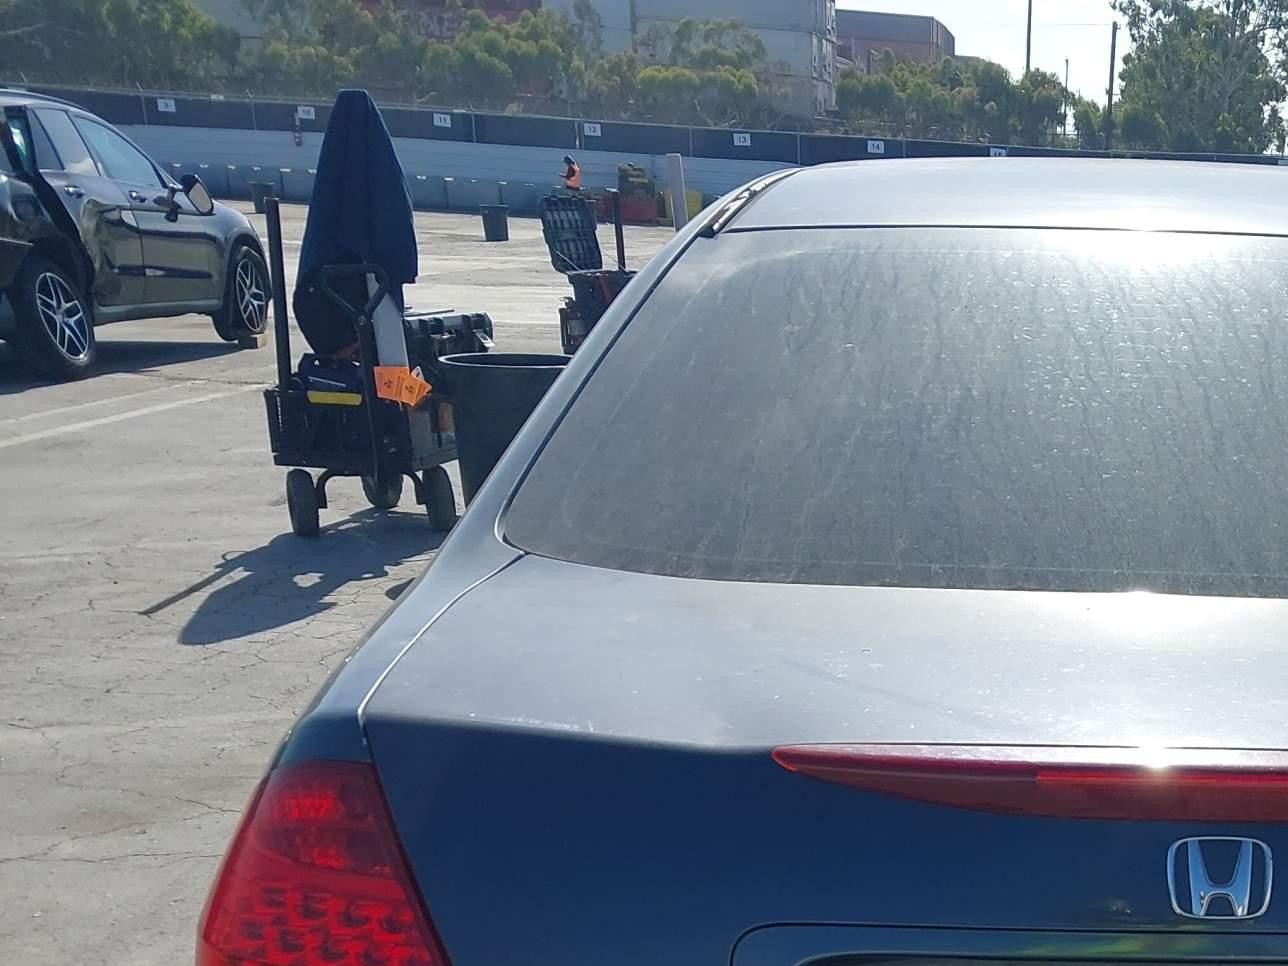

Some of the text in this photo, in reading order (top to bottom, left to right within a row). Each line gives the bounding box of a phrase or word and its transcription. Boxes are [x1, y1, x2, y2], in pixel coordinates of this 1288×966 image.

[302, 109, 311, 117] 10
[438, 116, 447, 124] 11
[871, 143, 880, 151] 14
